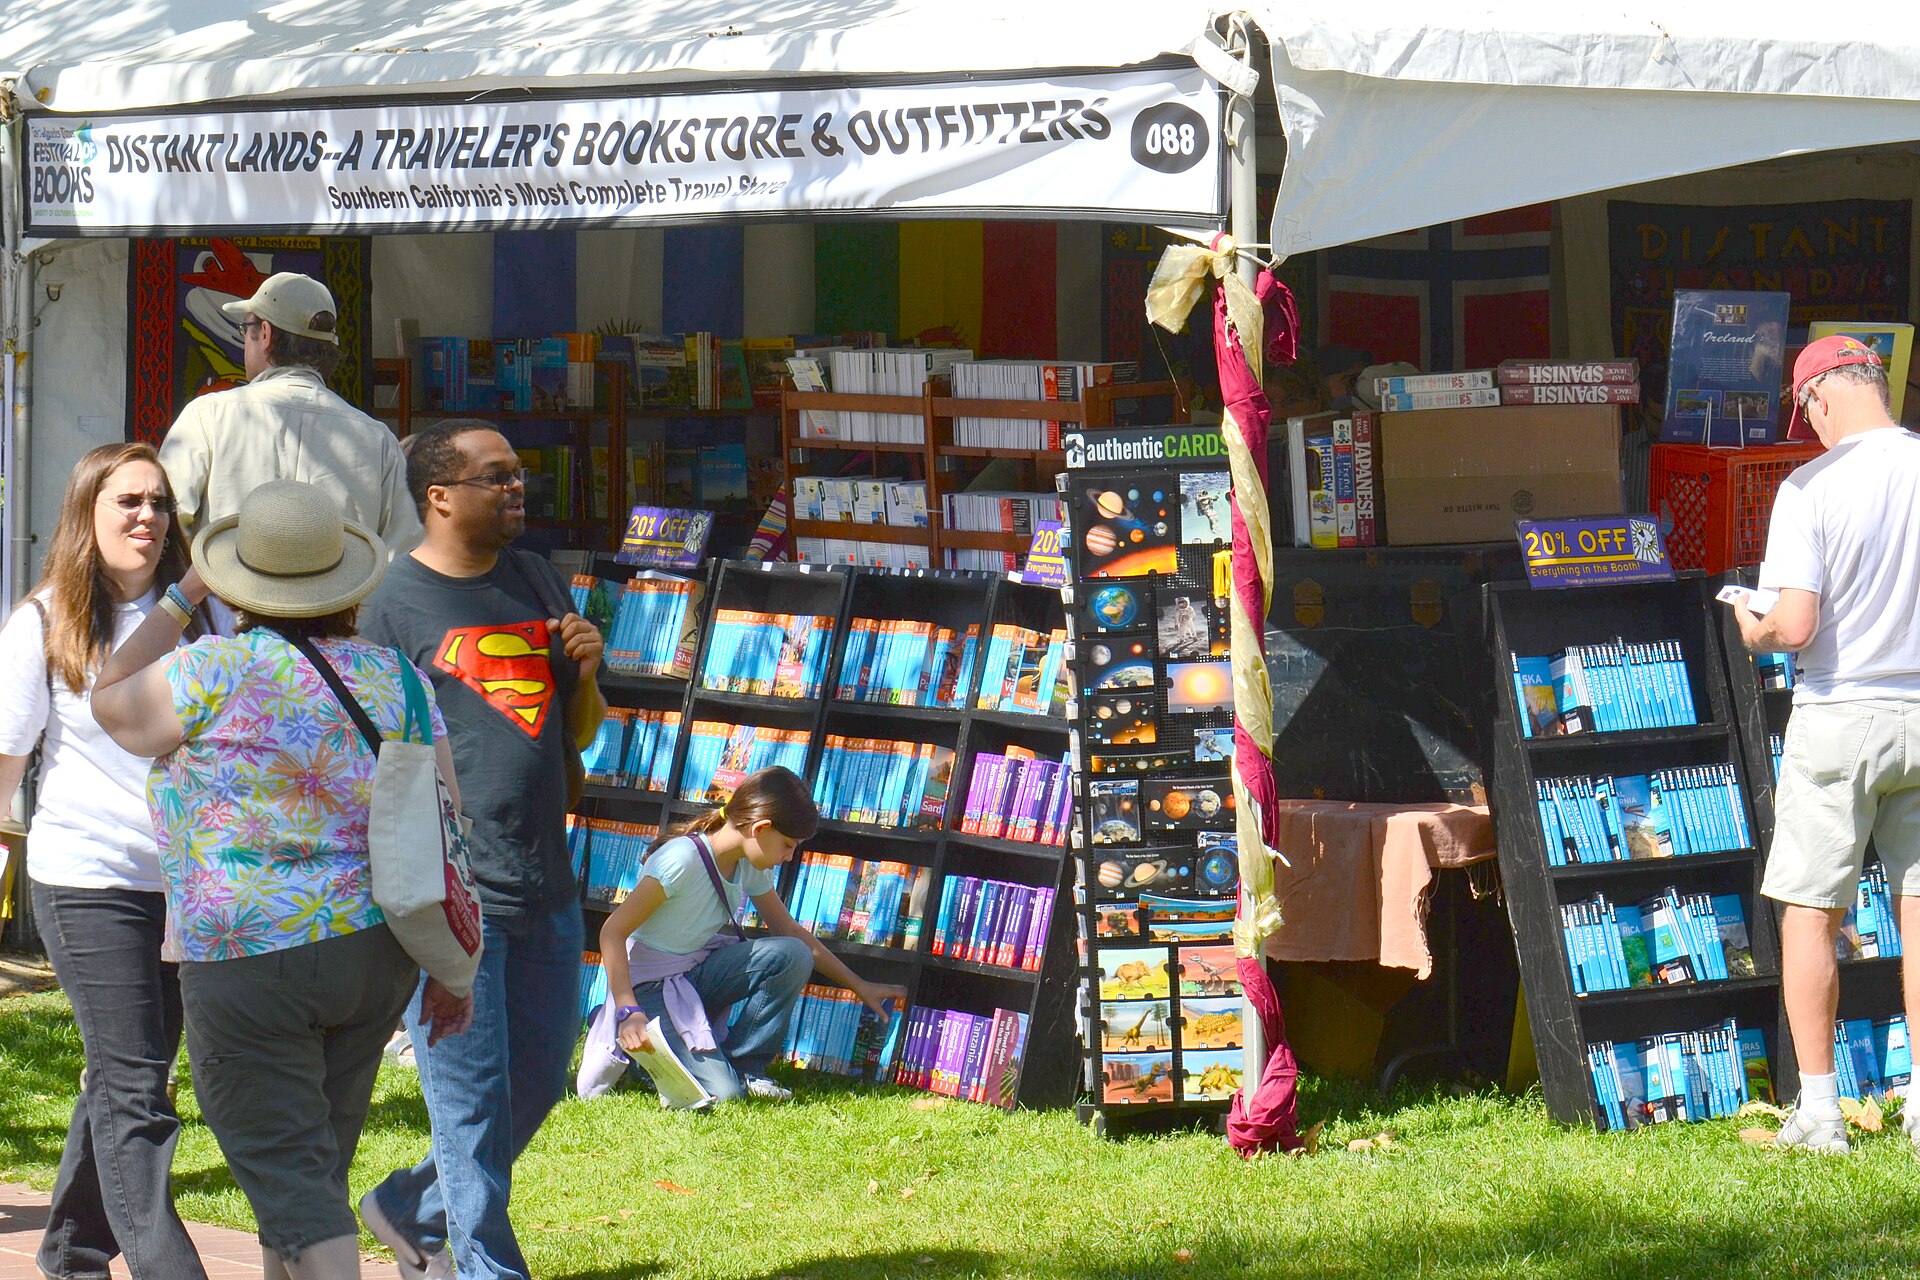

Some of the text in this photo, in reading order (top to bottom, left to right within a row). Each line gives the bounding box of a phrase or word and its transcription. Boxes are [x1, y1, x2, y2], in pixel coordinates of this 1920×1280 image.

[107, 132, 224, 174] DISTANT
[374, 121, 573, 174] TRAVELER'S
[574, 112, 806, 167] BOOKSTORE
[811, 111, 845, 157] &
[847, 97, 1112, 155] OUTFITTERS
[1145, 121, 1196, 156] 088
[34, 141, 96, 162] FESTIVAL OF
[34, 165, 94, 203] BOOKS
[330, 176, 787, 211] Southern California's Most Complete Travel Store
[256, 236, 318, 248] bookstore
[1637, 216, 1889, 261] DISTANT
[1703, 331, 1756, 343] Ireland
[1529, 365, 1604, 384] SPANISH
[1533, 385, 1609, 404] SPANISH
[1320, 446, 1333, 492] HEBREW
[1343, 462, 1352, 497] French
[1355, 441, 1374, 519] JAPANESE
[627, 515, 690, 539] 20% OFF
[1524, 528, 1627, 557] 20% OFF
[621, 544, 650, 556] Everything
[656, 546, 665, 555] the
[1026, 561, 1056, 577] Everything
[1531, 562, 1641, 578] Everything in the Booth!
[1624, 574, 1651, 582] independent
[869, 655, 880, 684] Zealand
[1631, 667, 1640, 690] BAJA
[1650, 666, 1661, 704] BERMUDA
[1663, 663, 1675, 697] BRAZIL
[1584, 670, 1597, 713] ARIZONA
[1592, 670, 1604, 706] ARIZONA
[1599, 669, 1612, 705] ARIZONA
[1638, 667, 1649, 705] BALTIMORE
[1676, 685, 1685, 712] COLUMBIA
[1683, 684, 1692, 711] COLUMBIA
[654, 729, 666, 765] Australia
[662, 729, 673, 765] Australia
[700, 739, 712, 770] France
[708, 741, 719, 772] France
[714, 771, 737, 784] Europe
[818, 752, 829, 781] Poland
[1548, 803, 1557, 826] CABO
[1680, 792, 1693, 832] CAMBODIA
[1689, 791, 1701, 831] CAMBODIA
[1734, 786, 1745, 824] CHARLOTTE
[1563, 800, 1582, 849] CALIFORNIA
[1571, 800, 1590, 849] CALIFORNIA
[607, 838, 619, 872] Britain
[792, 869, 805, 904] Scotland
[872, 880, 883, 903] South
[952, 881, 964, 906] Europe
[825, 895, 836, 915] Africa
[1040, 898, 1051, 921] Peru
[1718, 914, 1740, 924] PICCHU
[852, 914, 869, 930] Sicily
[904, 922, 919, 934] Spain
[1622, 925, 1641, 935] RICA
[1703, 918, 1712, 944] CUBA
[1710, 917, 1719, 943] CUBA
[1565, 930, 1575, 967] CHESAPEAKE
[1577, 928, 1587, 962] CHIAPAS
[1585, 927, 1596, 957] CHILE
[1595, 926, 1606, 957] CHILE
[1613, 925, 1624, 961] COLORADO
[966, 1021, 983, 1064] Tanzania
[993, 1038, 1002, 1055] World
[997, 1016, 1013, 1065] Wine Travel Guide
[1695, 1075, 1703, 1105] CORNERS
[1709, 1055, 1720, 1105] GUADALAJARA
[1716, 1054, 1728, 1097] GUATEMALA
[1724, 1053, 1735, 1096] GUATEMALA
[1690, 1076, 1698, 1105] CORNERS
